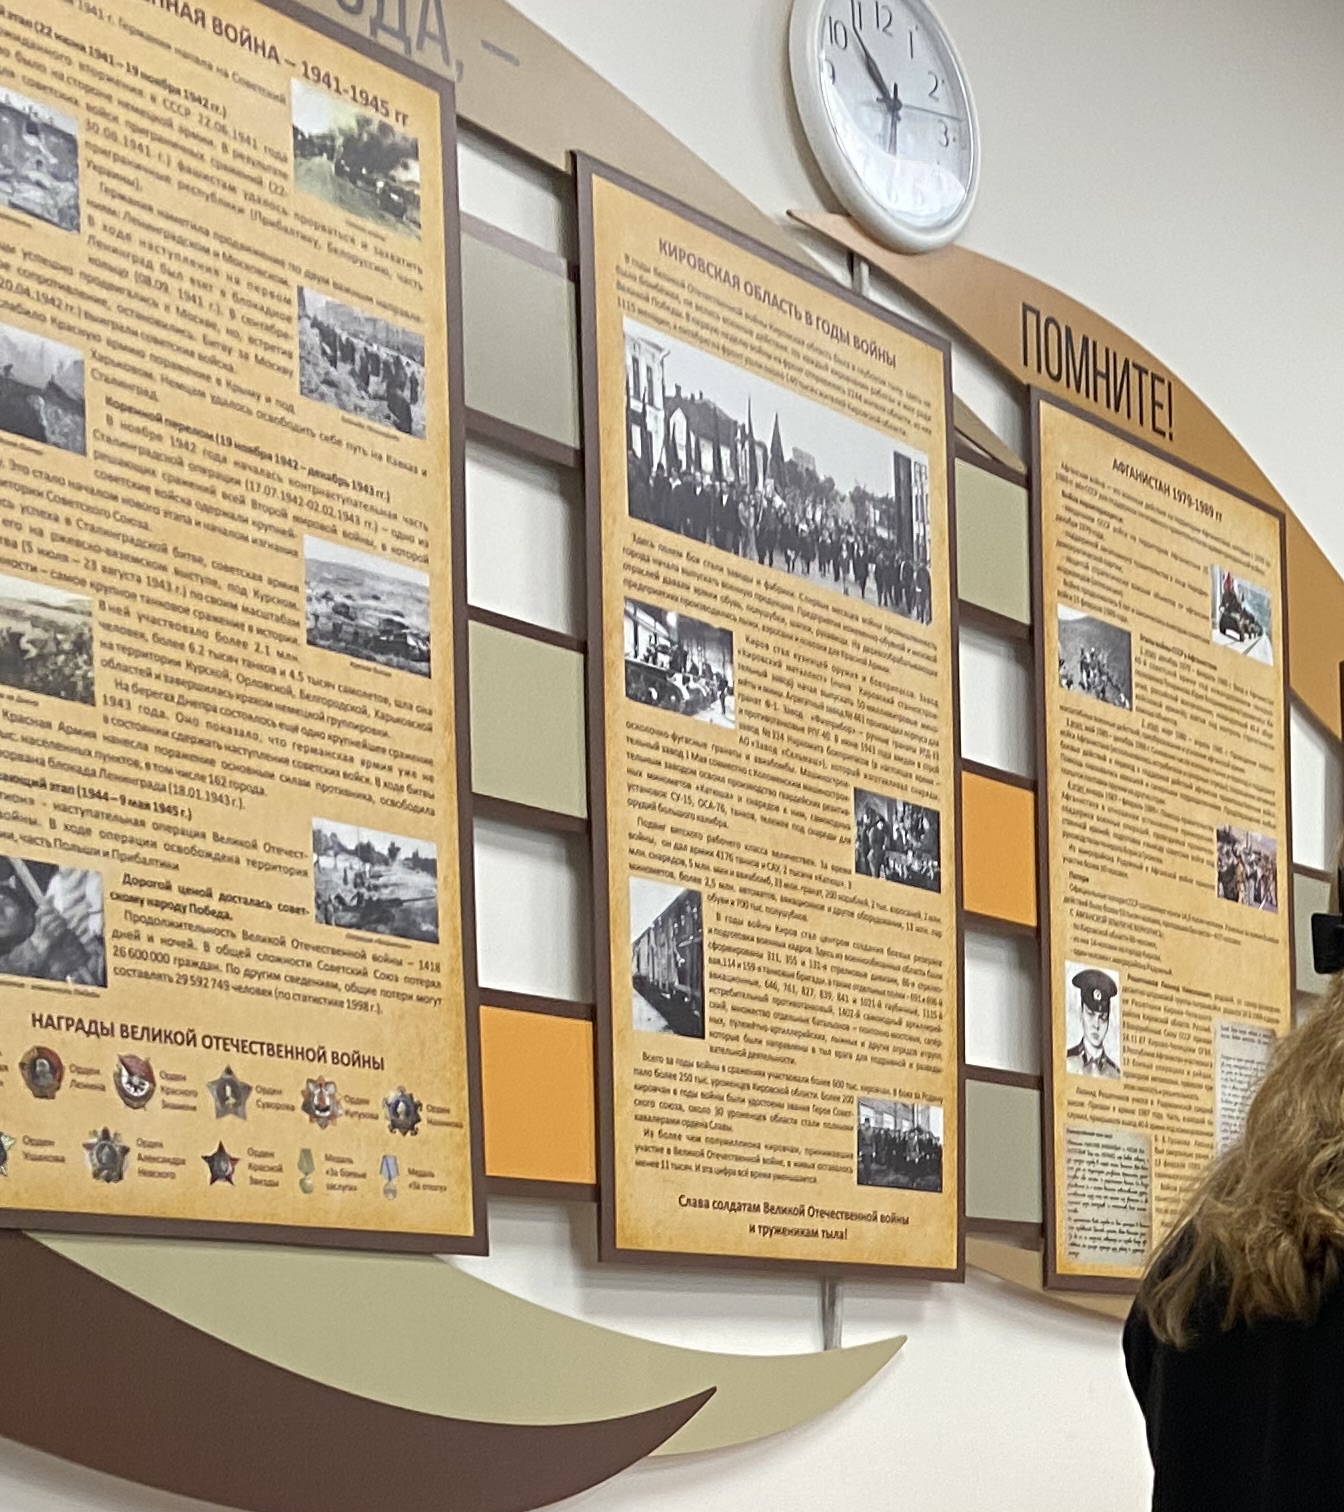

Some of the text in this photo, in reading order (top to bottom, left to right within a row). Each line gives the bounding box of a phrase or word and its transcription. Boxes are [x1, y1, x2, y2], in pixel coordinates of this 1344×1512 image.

[829, 16, 848, 49] 10
[876, 1, 894, 37] 12
[212, 17, 279, 63] ВОЙНА
[303, 62, 389, 117] 1941-1945
[928, 71, 939, 101] 2
[937, 119, 950, 147] 3
[659, 240, 896, 368] КИРОВСКАЯ ОБЛАСТЬ В ГОДЫ ВОЙНЫ
[1022, 302, 1174, 441] ПОМНИТЕ!
[1113, 460, 1170, 496] АФГАНИСТАН
[1173, 488, 1214, 518] 1979-1989
[32, 1013, 384, 1070] НАГРАДЫ ВЕЛИКОЙ ОТЕЧЕСТВЕННОЙ ВОЙНЫ
[678, 1194, 909, 1225] Слава солдатам Великой Отечественной войны
[749, 1224, 848, 1240] и труженикам тыла!
